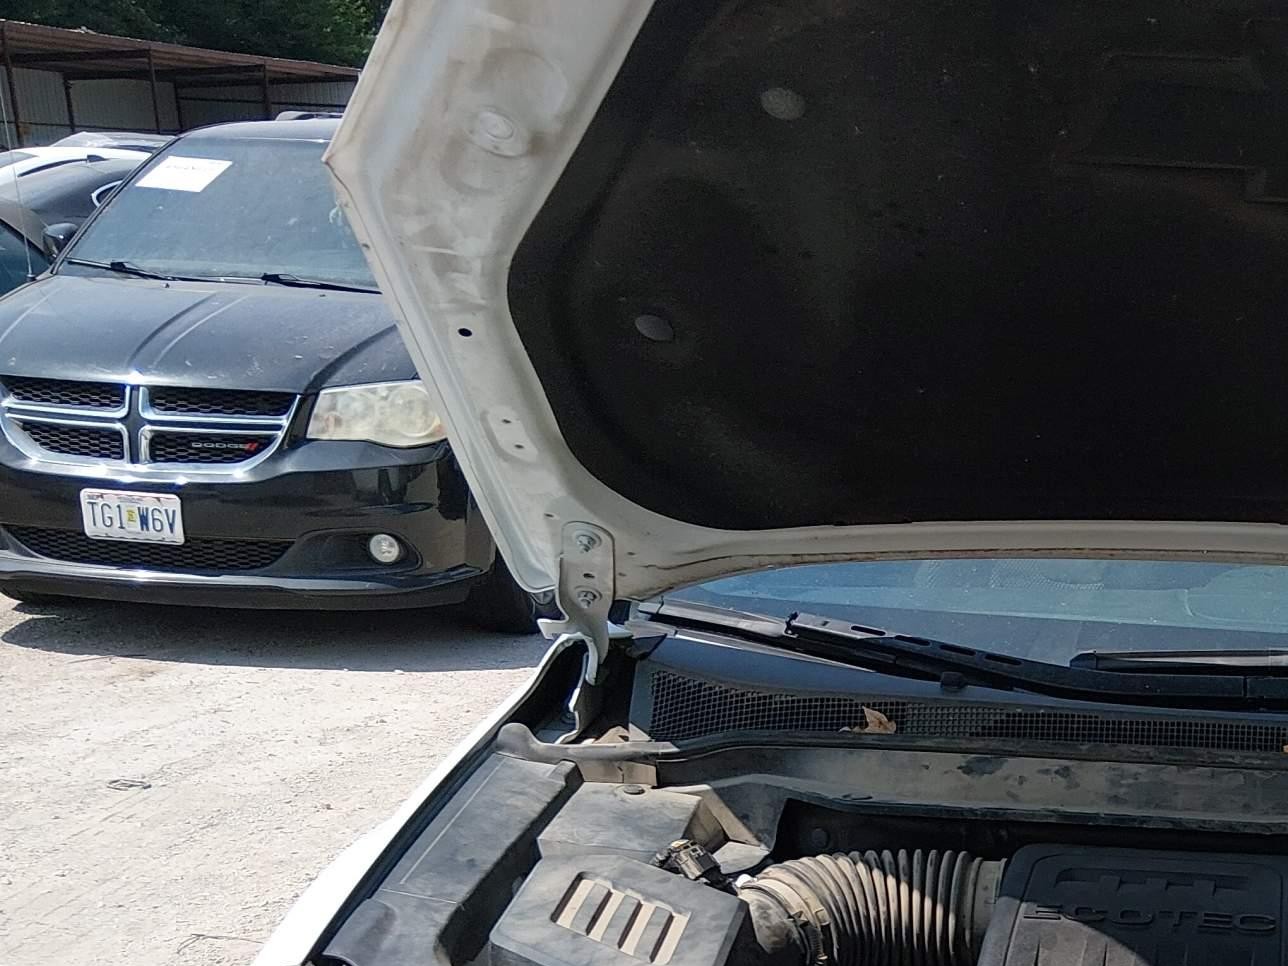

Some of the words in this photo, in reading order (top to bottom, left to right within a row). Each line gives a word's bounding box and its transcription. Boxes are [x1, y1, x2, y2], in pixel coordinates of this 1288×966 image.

[87, 501, 126, 530] TG1
[137, 506, 176, 534] W6V
[1022, 904, 1277, 933] ECOTEC
